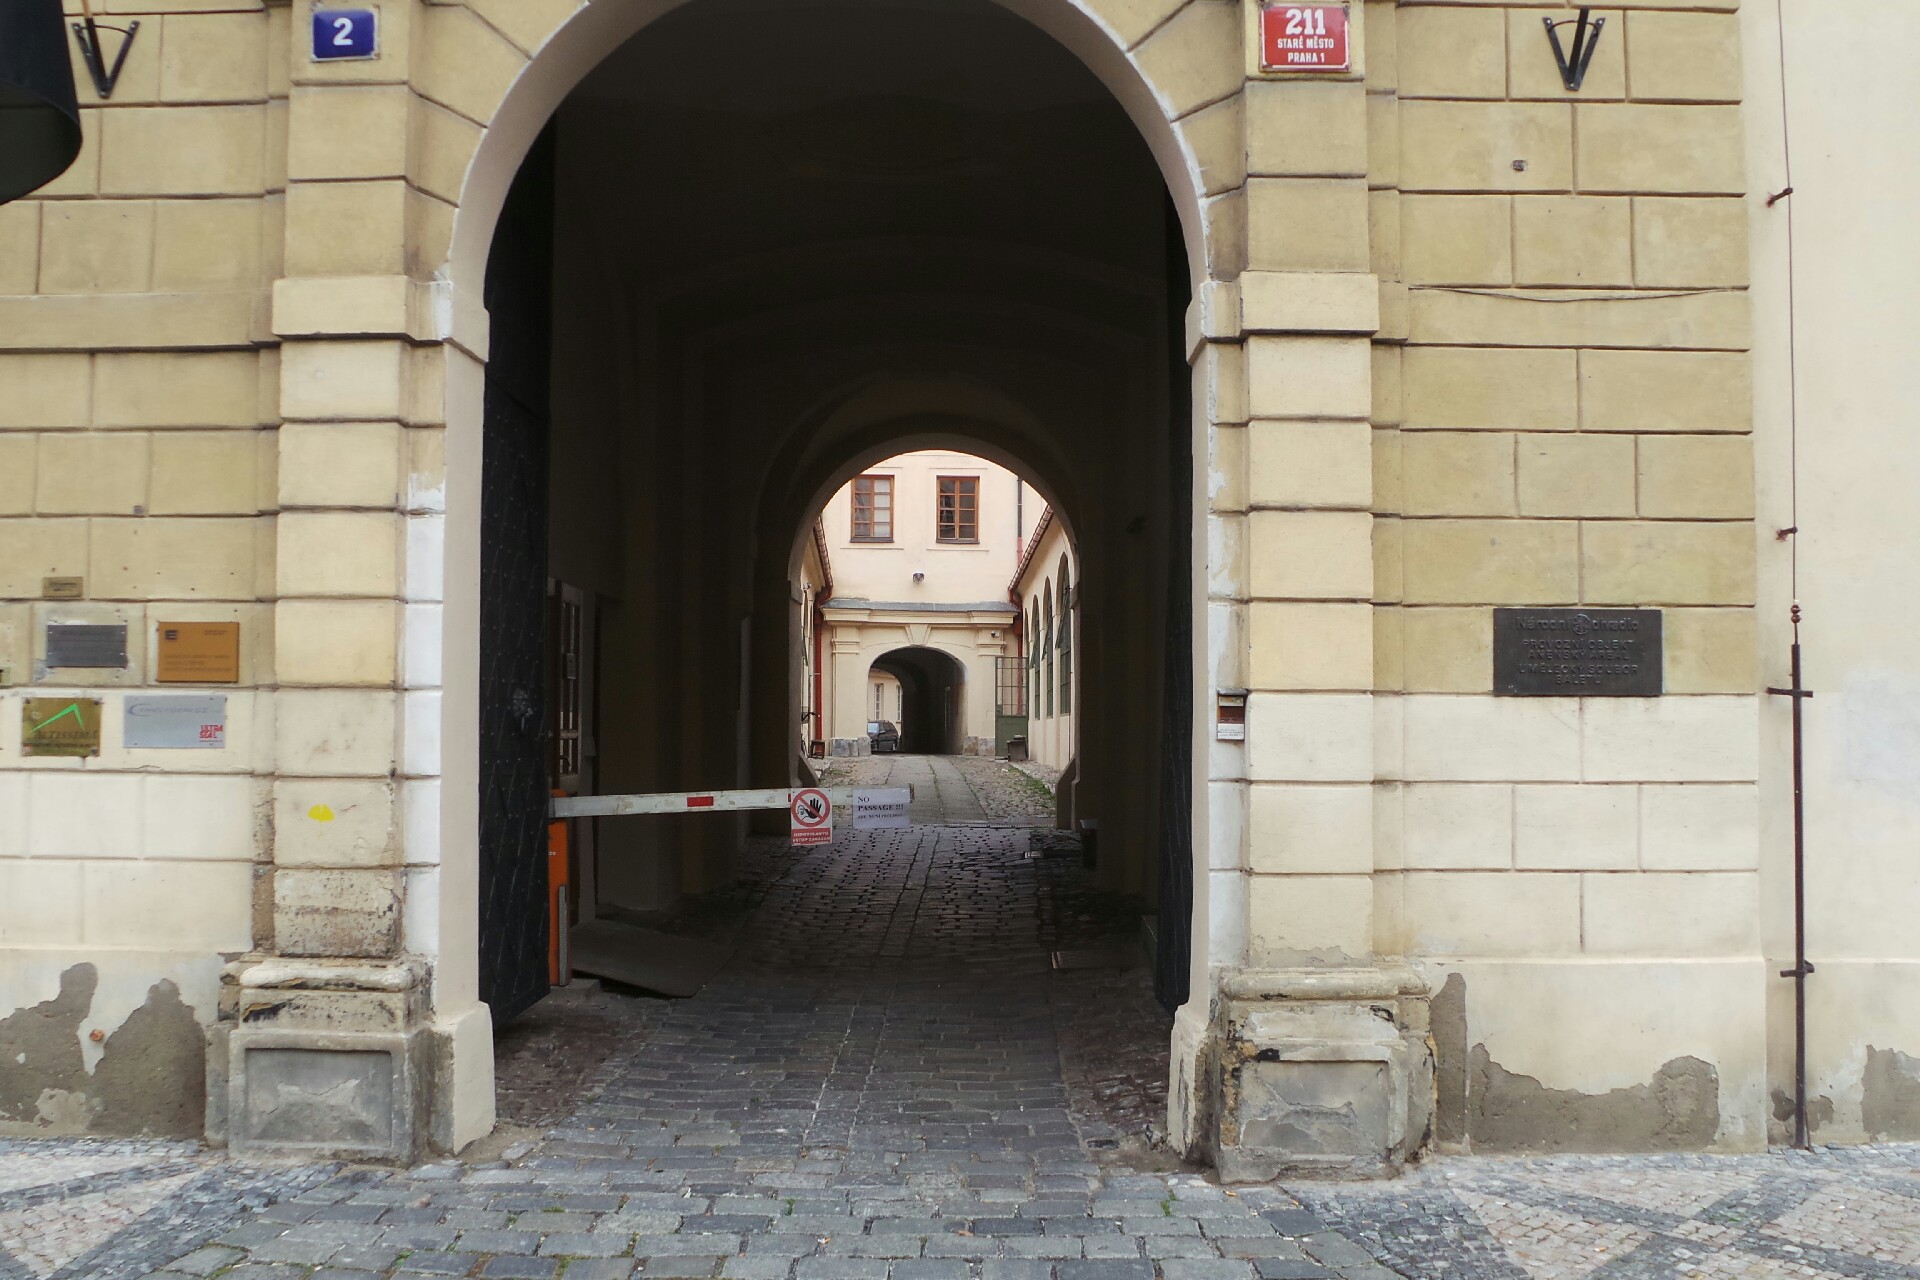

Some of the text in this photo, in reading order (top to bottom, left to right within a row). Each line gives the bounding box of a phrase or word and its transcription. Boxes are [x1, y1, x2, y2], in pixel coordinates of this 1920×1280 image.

[1285, 8, 1326, 35] 211
[332, 17, 354, 46] 2
[1277, 35, 1334, 49] STARÉ MĚSTO
[1287, 52, 1325, 63] PRAHA 1
[1589, 639, 1635, 650] OBJEKT
[1588, 664, 1639, 675] SOUBOR
[1556, 674, 1601, 684] BALETU
